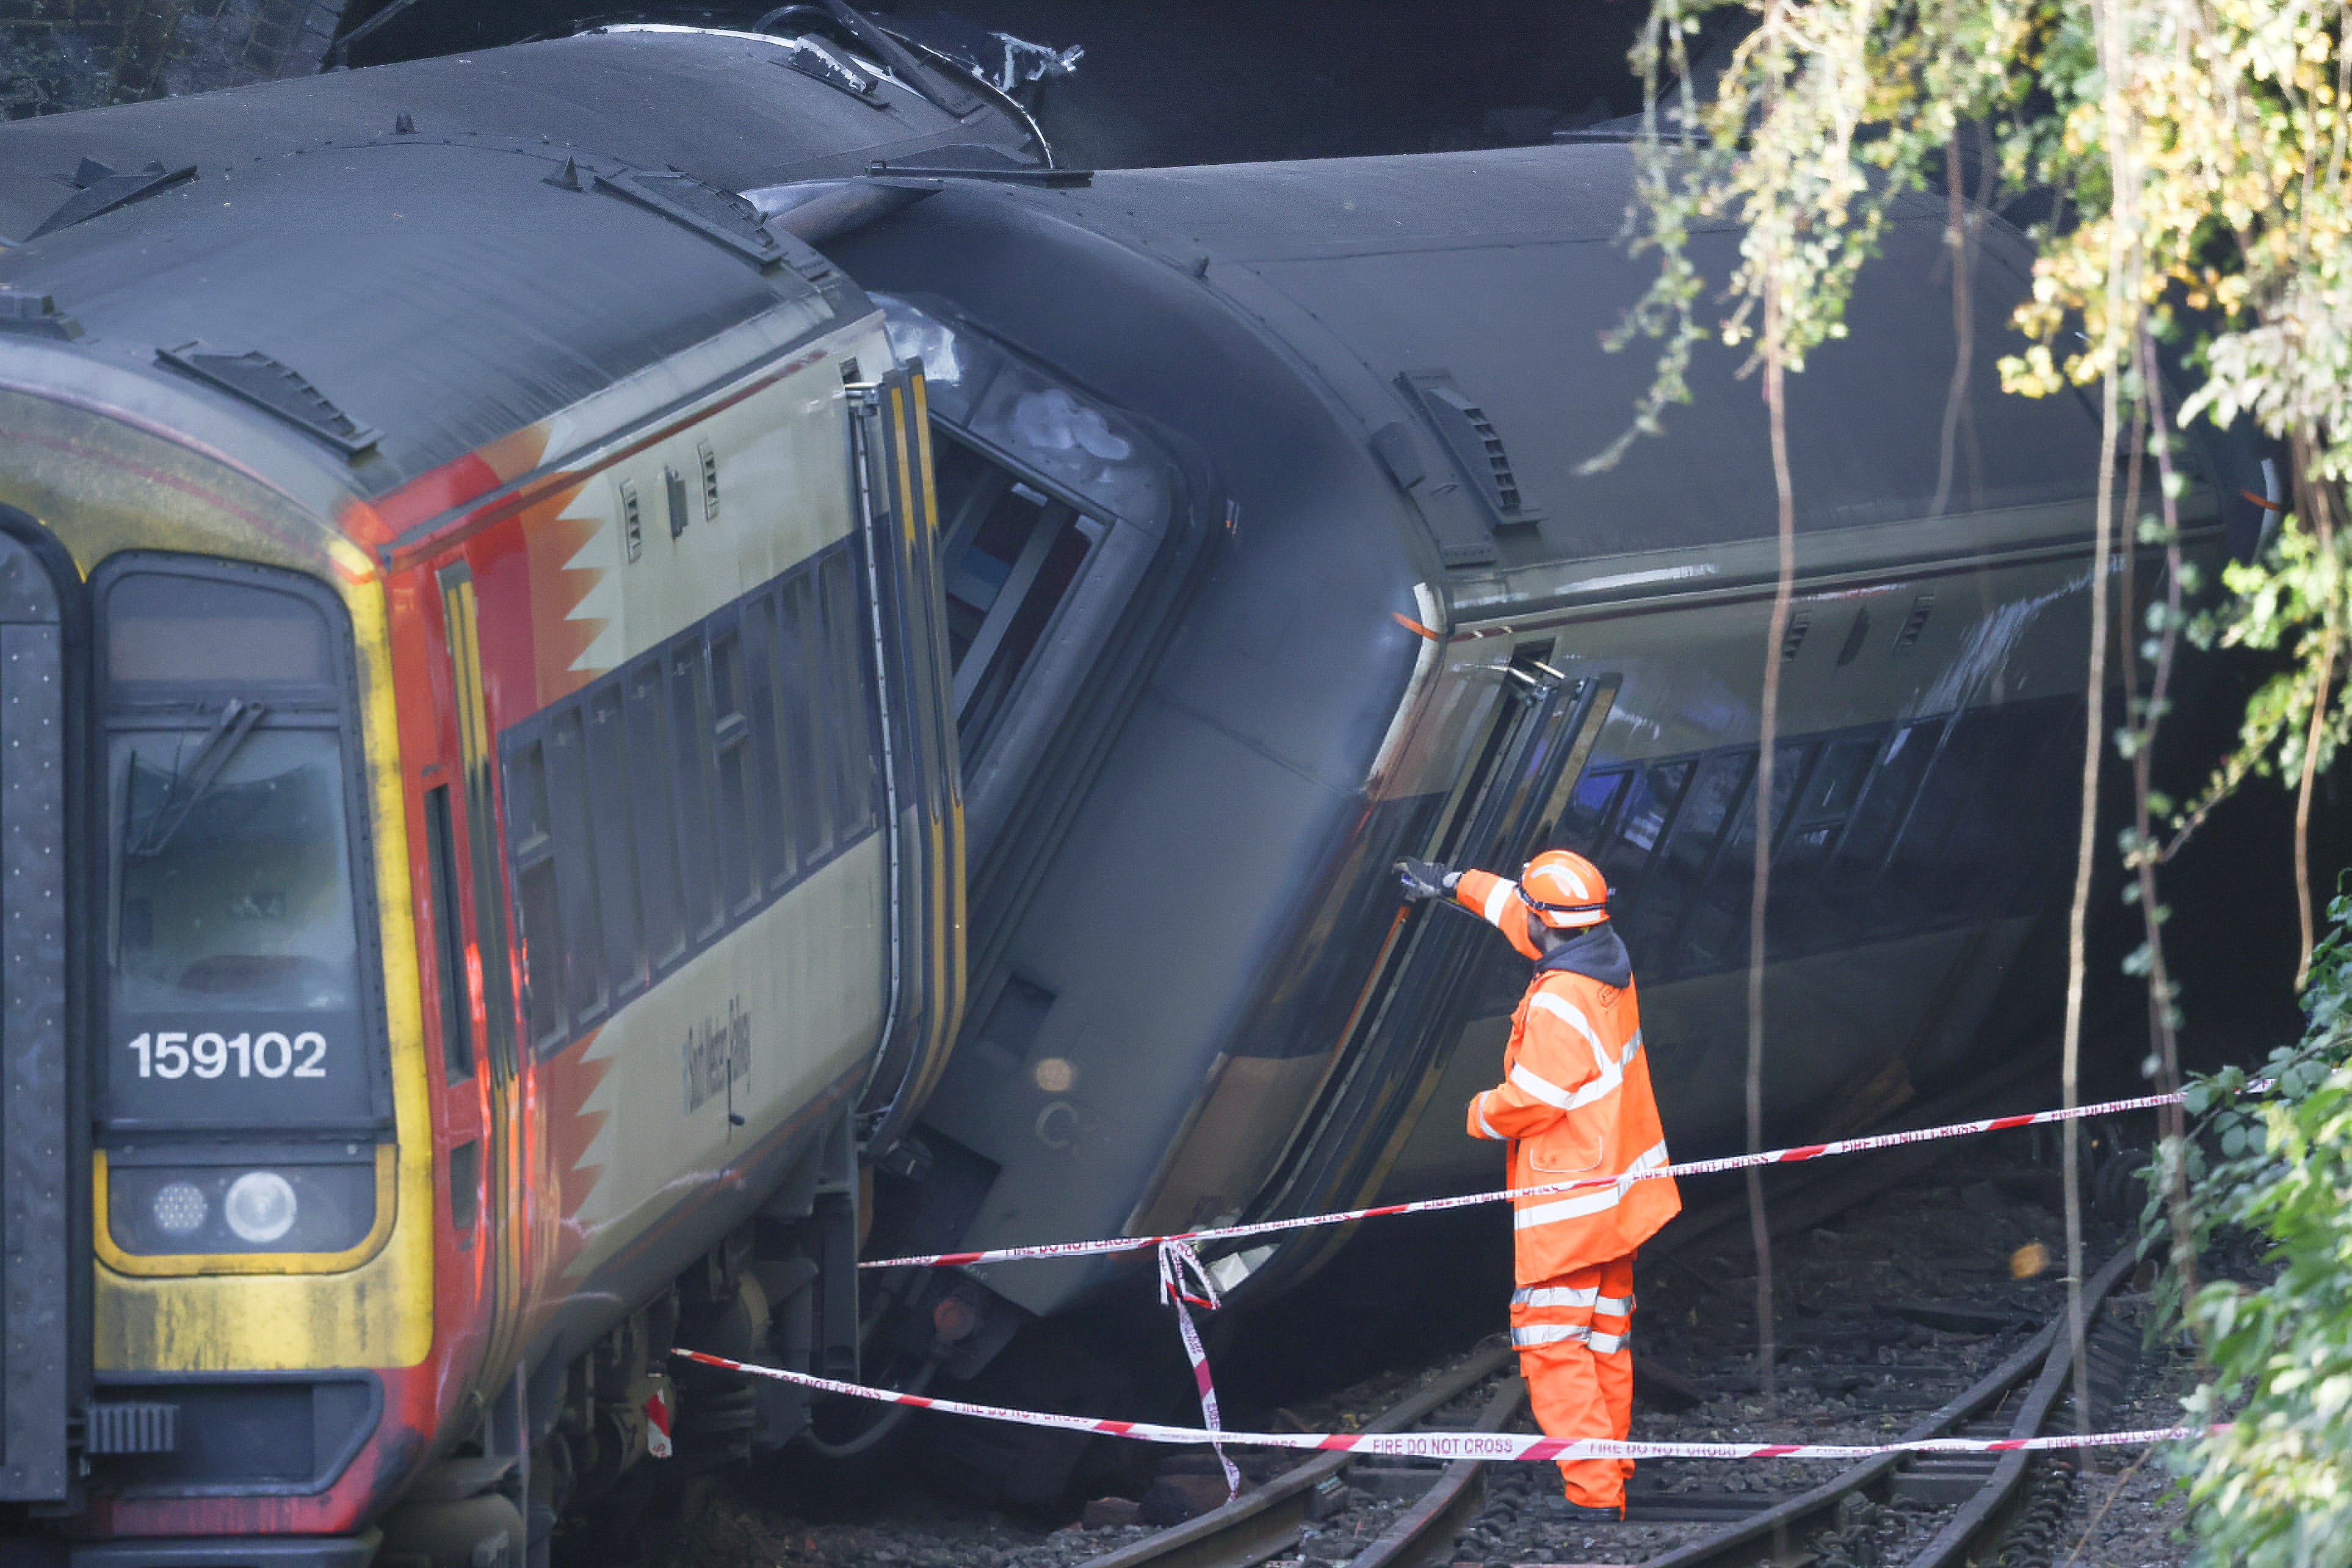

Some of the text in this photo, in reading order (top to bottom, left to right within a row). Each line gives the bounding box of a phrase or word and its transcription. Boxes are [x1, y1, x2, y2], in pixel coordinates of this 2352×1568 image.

[128, 1031, 327, 1078] 159102
[1373, 1438, 1513, 1455] FIRE DO NOT CROSS
